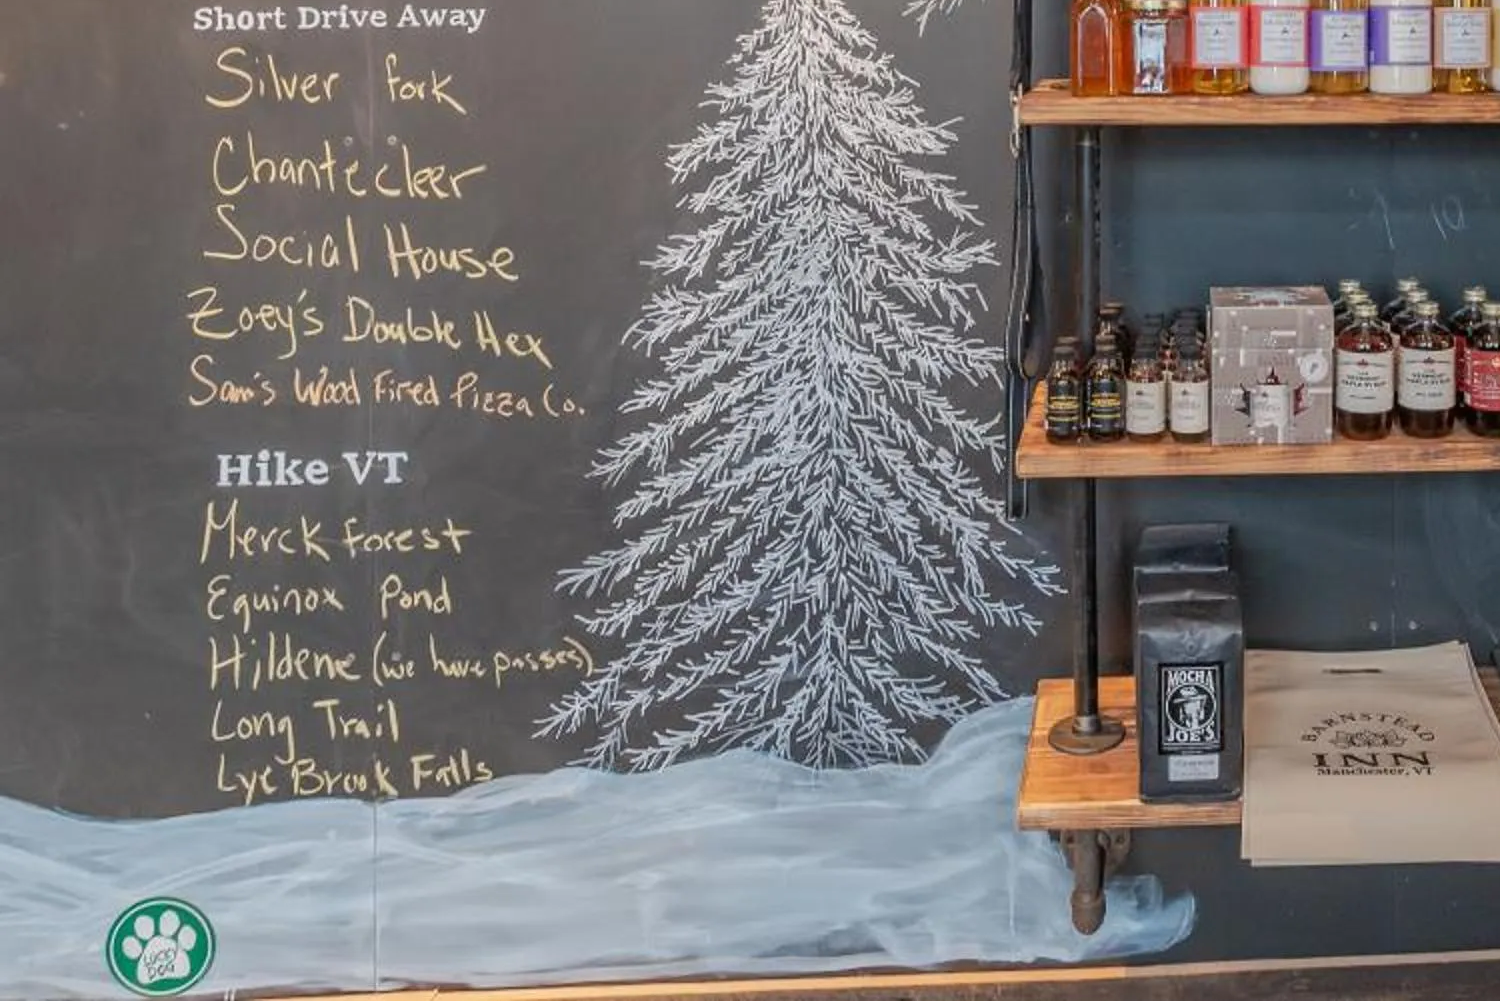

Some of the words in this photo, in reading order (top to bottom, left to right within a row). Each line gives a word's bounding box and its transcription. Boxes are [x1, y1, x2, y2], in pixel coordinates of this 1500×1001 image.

[193, 5, 288, 32] Short
[298, 4, 389, 30] Drive
[396, 5, 487, 34] Away
[205, 46, 340, 108] Silver
[203, 203, 359, 272] Social
[384, 222, 519, 280] House
[187, 286, 325, 360] Zoey's
[342, 295, 461, 350] Double
[473, 309, 553, 370] Hex
[294, 365, 361, 407] Wood
[373, 369, 440, 407] Fired
[450, 371, 533, 417] Pizza
[216, 448, 330, 488] Hike
[342, 451, 409, 486] VT
[200, 499, 331, 564] Merck
[207, 574, 345, 634] Equinox
[380, 574, 452, 620] Pond
[208, 631, 361, 691] Hildene
[429, 633, 488, 678] have
[1167, 670, 1215, 695] MOCHA
[211, 700, 296, 764] Long
[313, 699, 400, 742] Trail
[1167, 720, 1215, 742] JOE'S
[1301, 711, 1435, 742] BARNSTEAD
[291, 758, 399, 798] Brook
[410, 749, 493, 791] Falls
[1312, 751, 1432, 767] INN
